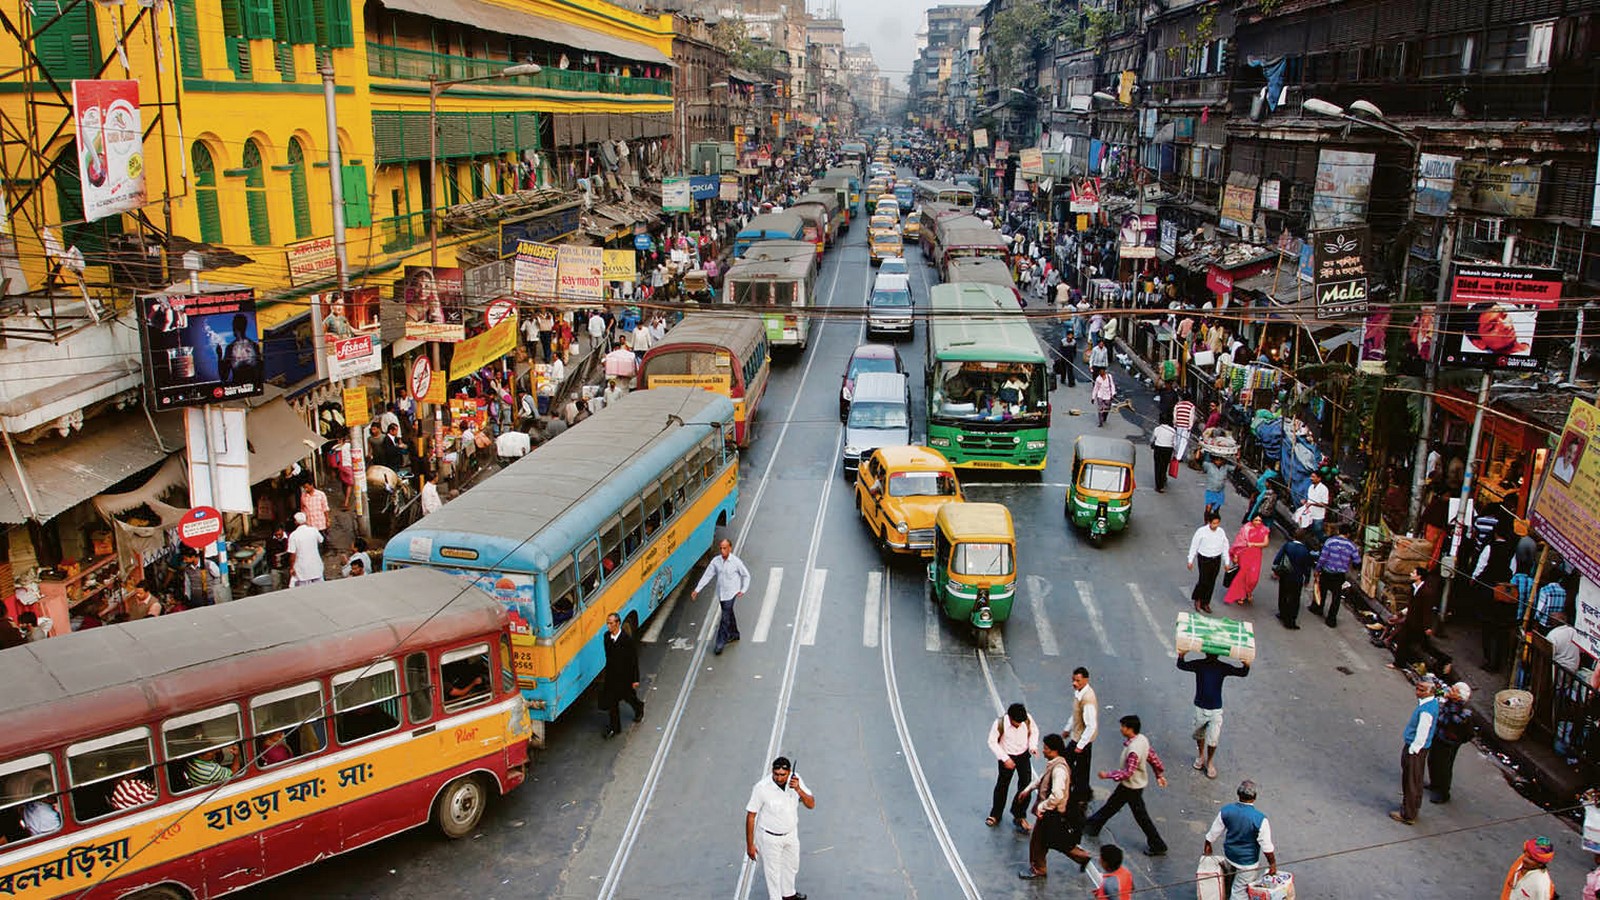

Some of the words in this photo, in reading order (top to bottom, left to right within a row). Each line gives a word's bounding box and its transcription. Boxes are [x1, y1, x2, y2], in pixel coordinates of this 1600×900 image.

[516, 241, 558, 260] ABHISHEK
[562, 275, 600, 288] Raymond
[1457, 279, 1479, 289] Died
[1494, 281, 1514, 290] Oral
[1515, 282, 1549, 293] Cancer
[1321, 281, 1366, 304] Mala
[337, 338, 369, 357] Ashok
[204, 790, 281, 831] হাওড়া
